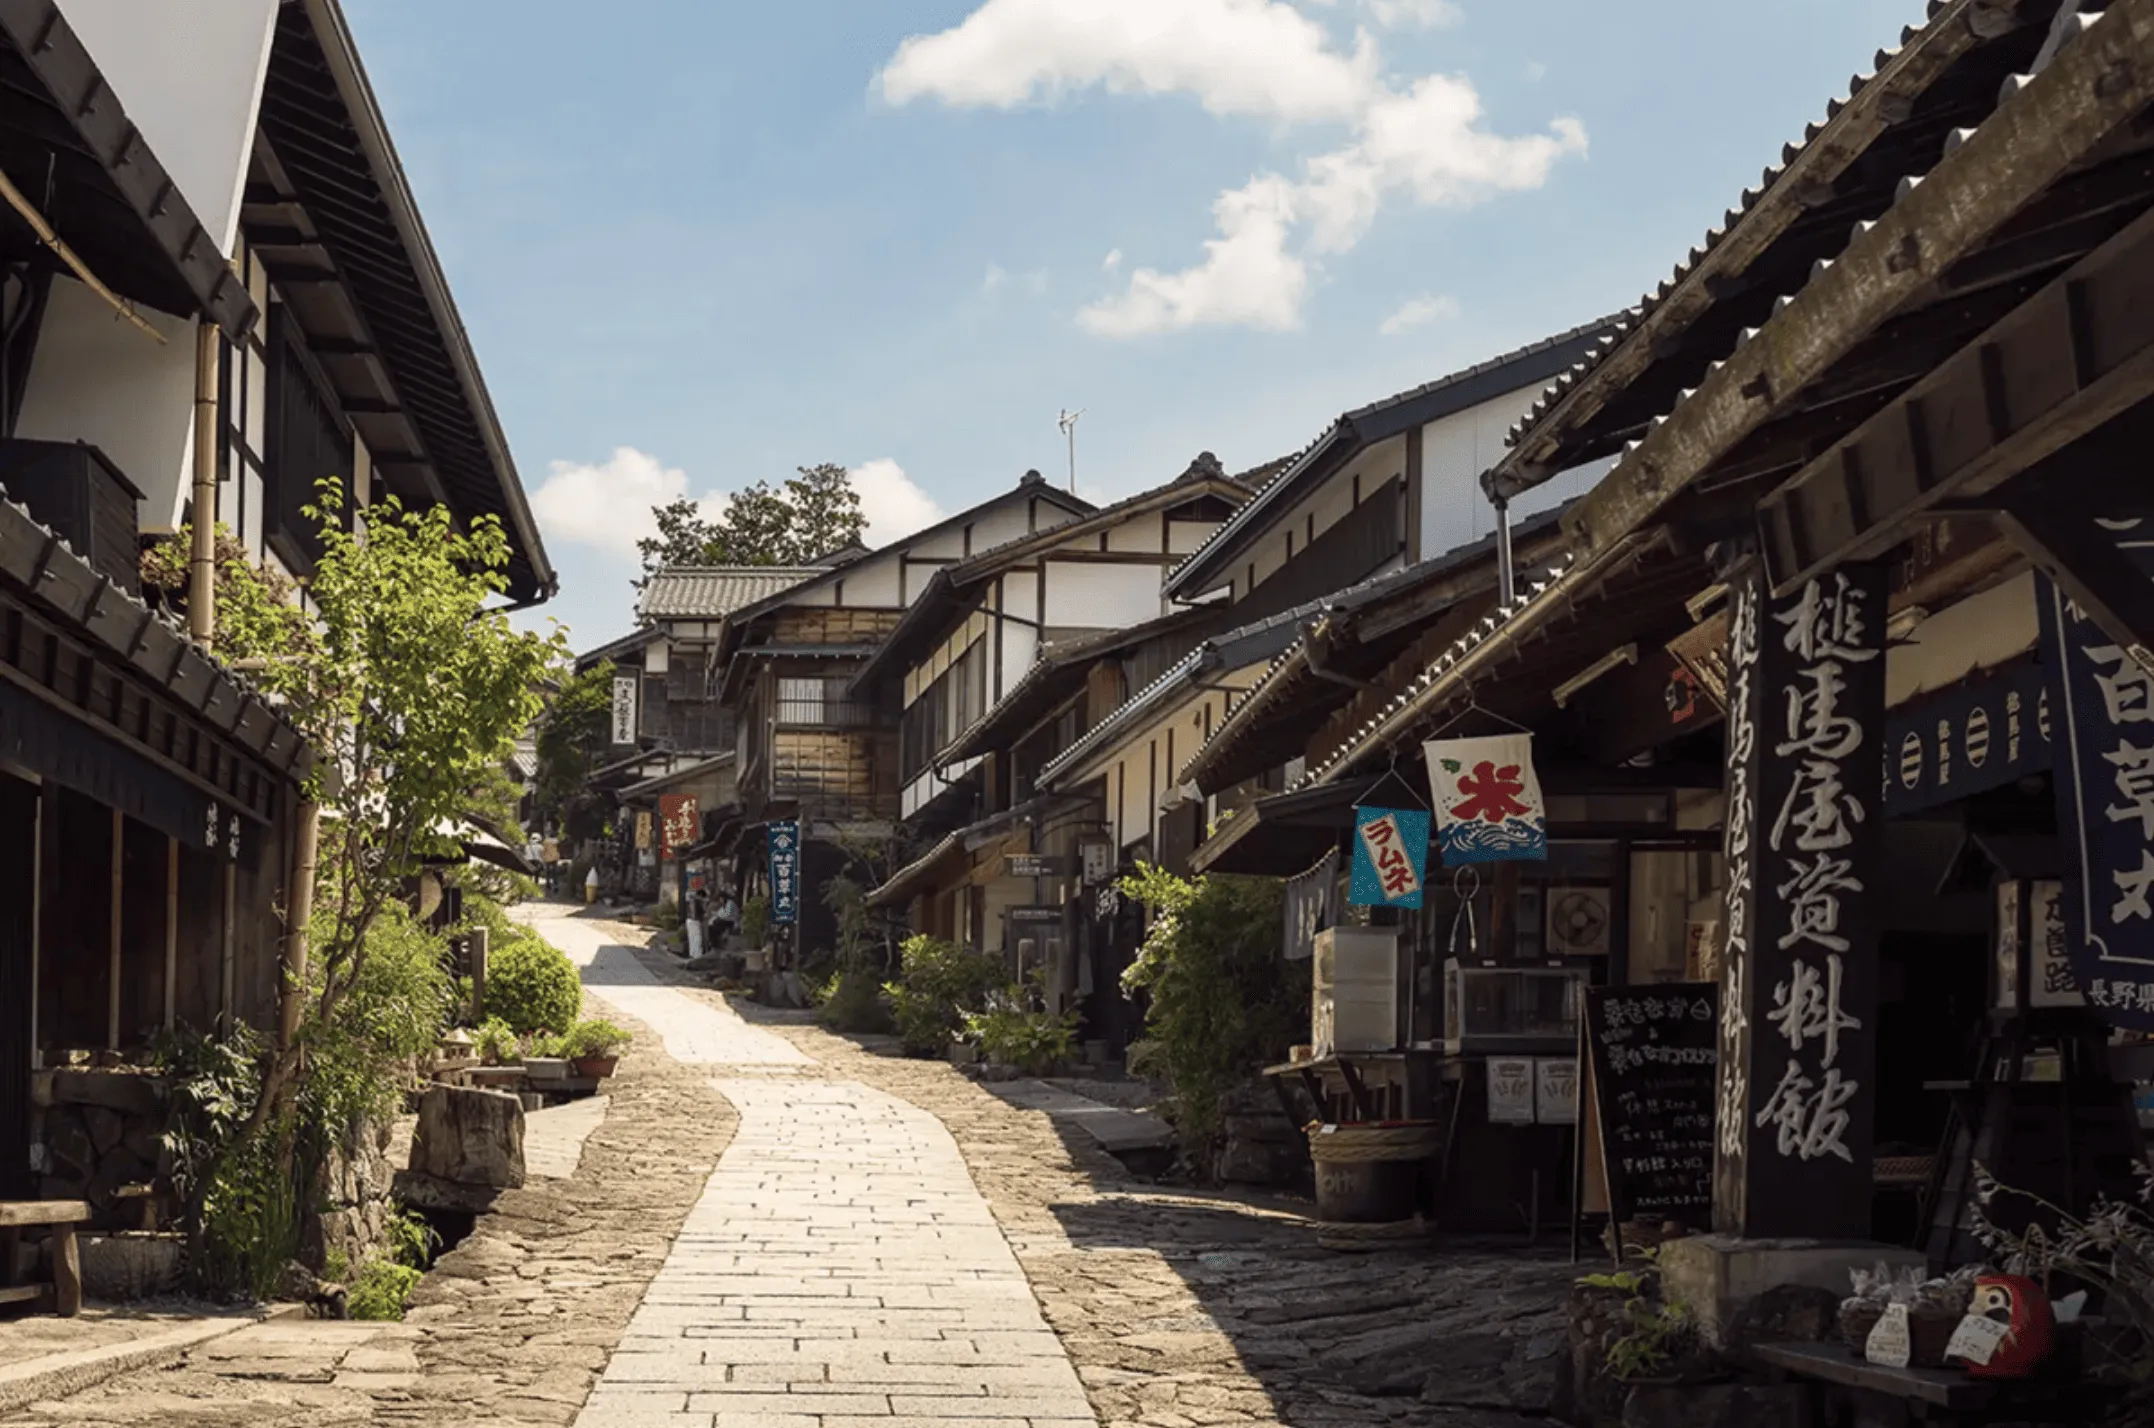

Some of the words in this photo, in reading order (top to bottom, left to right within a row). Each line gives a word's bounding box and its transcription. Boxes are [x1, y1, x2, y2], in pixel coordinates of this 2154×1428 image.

[1449, 759, 1533, 824] 氷
[1365, 817, 1416, 896] ラムネ
